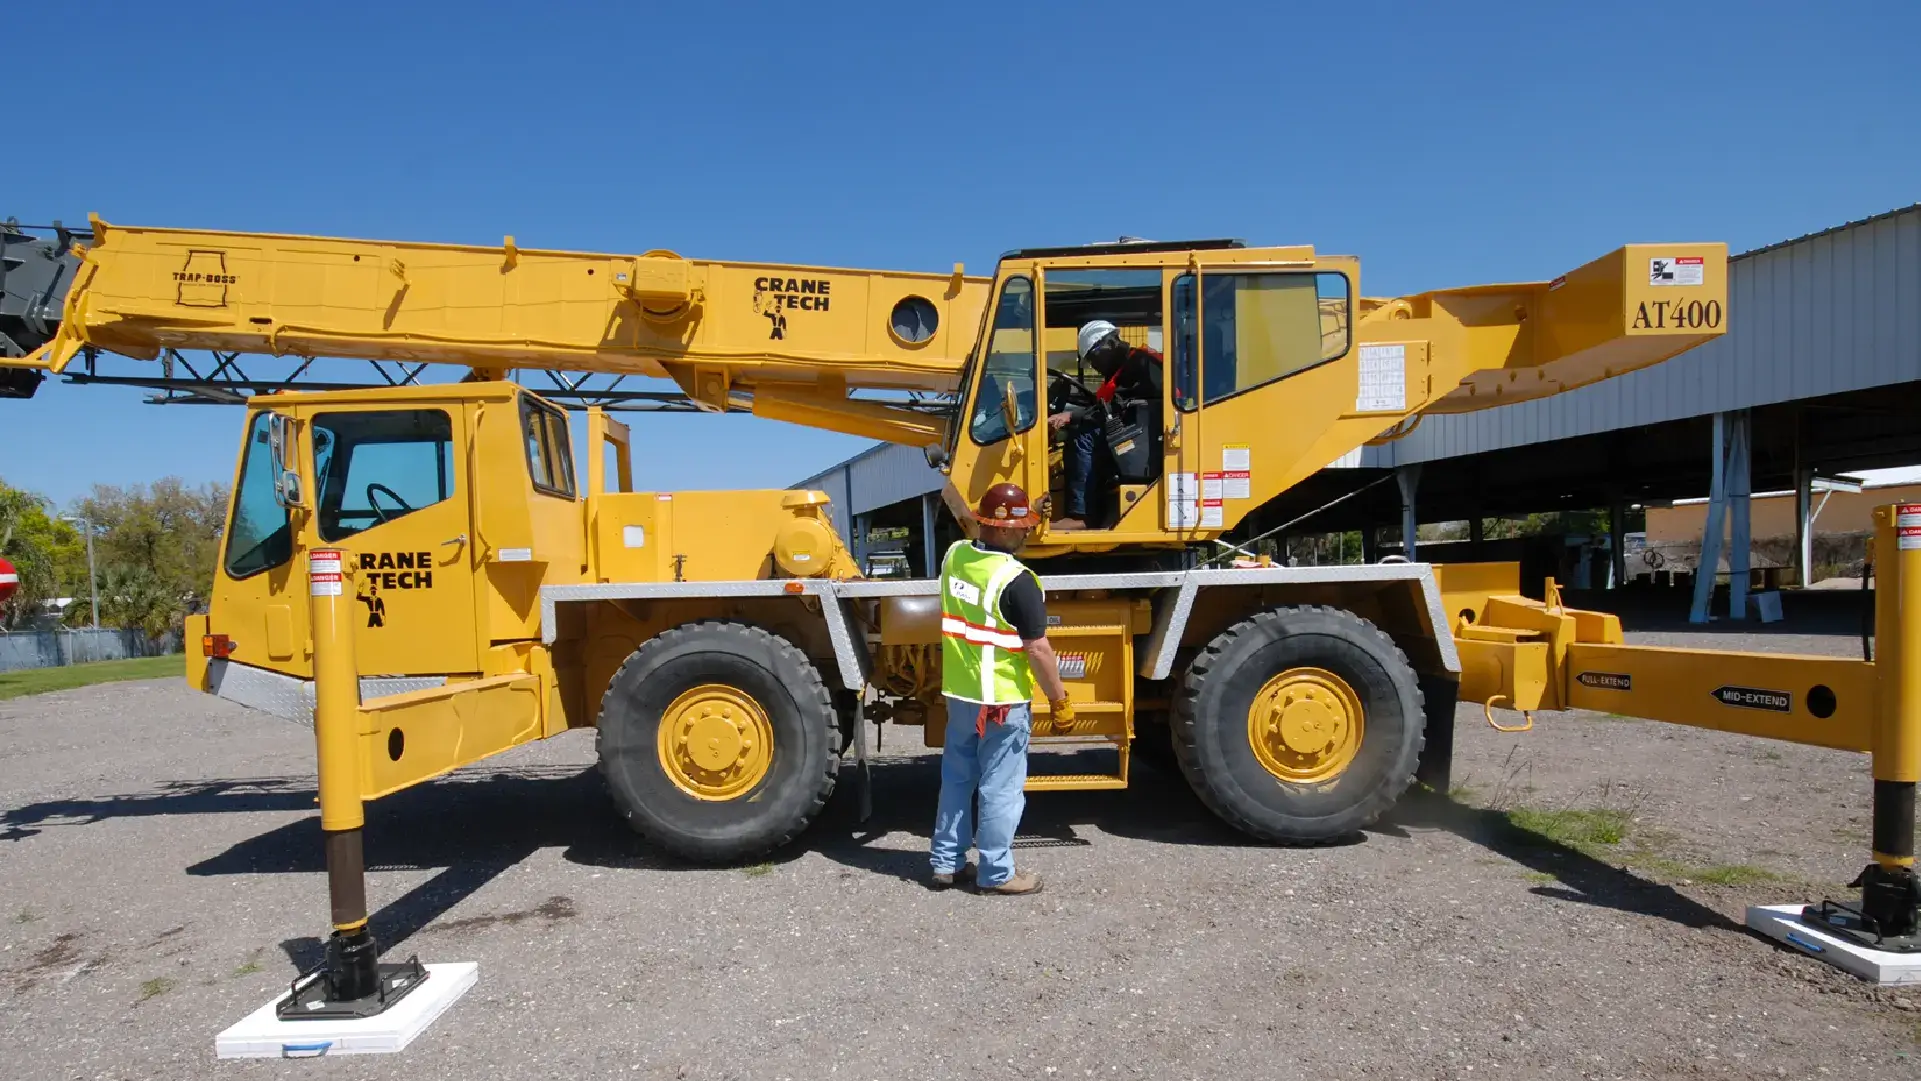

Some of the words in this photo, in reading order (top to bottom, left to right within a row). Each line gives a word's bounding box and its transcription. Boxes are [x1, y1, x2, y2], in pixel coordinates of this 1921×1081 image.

[755, 277, 831, 294] CRANE
[773, 294, 830, 311] TECH
[1631, 297, 1722, 329] AT400
[356, 552, 432, 570] RANE
[366, 571, 433, 590] TECH
[1722, 690, 1788, 707] MID-EXTEND
